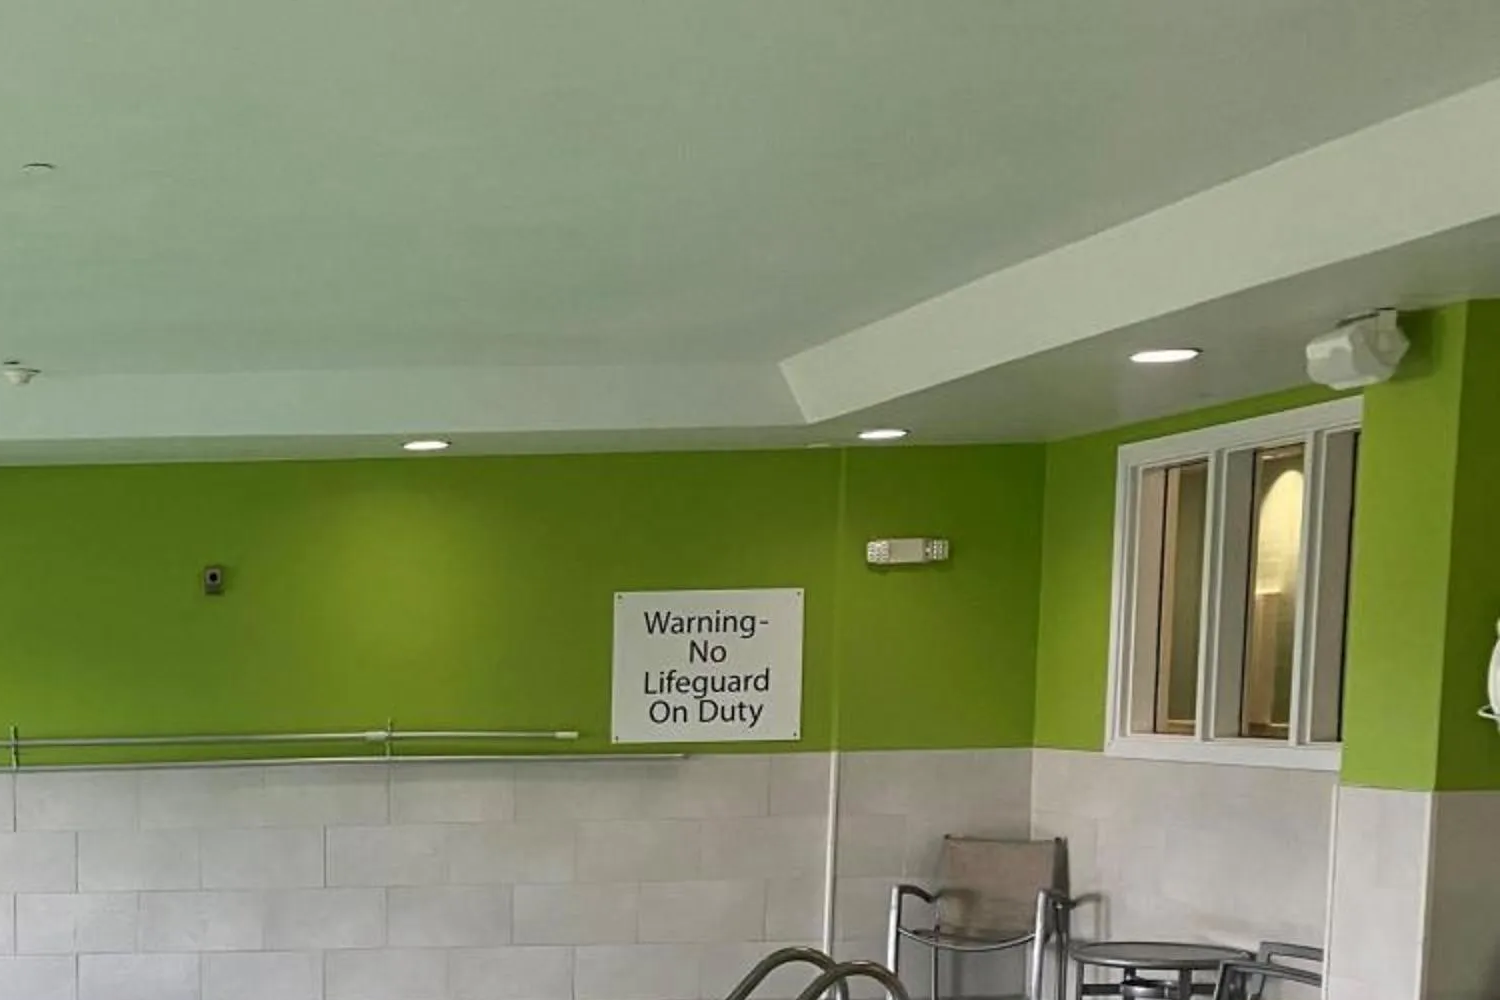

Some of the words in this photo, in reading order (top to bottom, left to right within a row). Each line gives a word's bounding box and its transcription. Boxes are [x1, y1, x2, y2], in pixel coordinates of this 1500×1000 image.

[689, 639, 727, 664] No
[644, 667, 770, 699] Lifeguard
[649, 699, 688, 724] On
[698, 700, 765, 729] Duty
